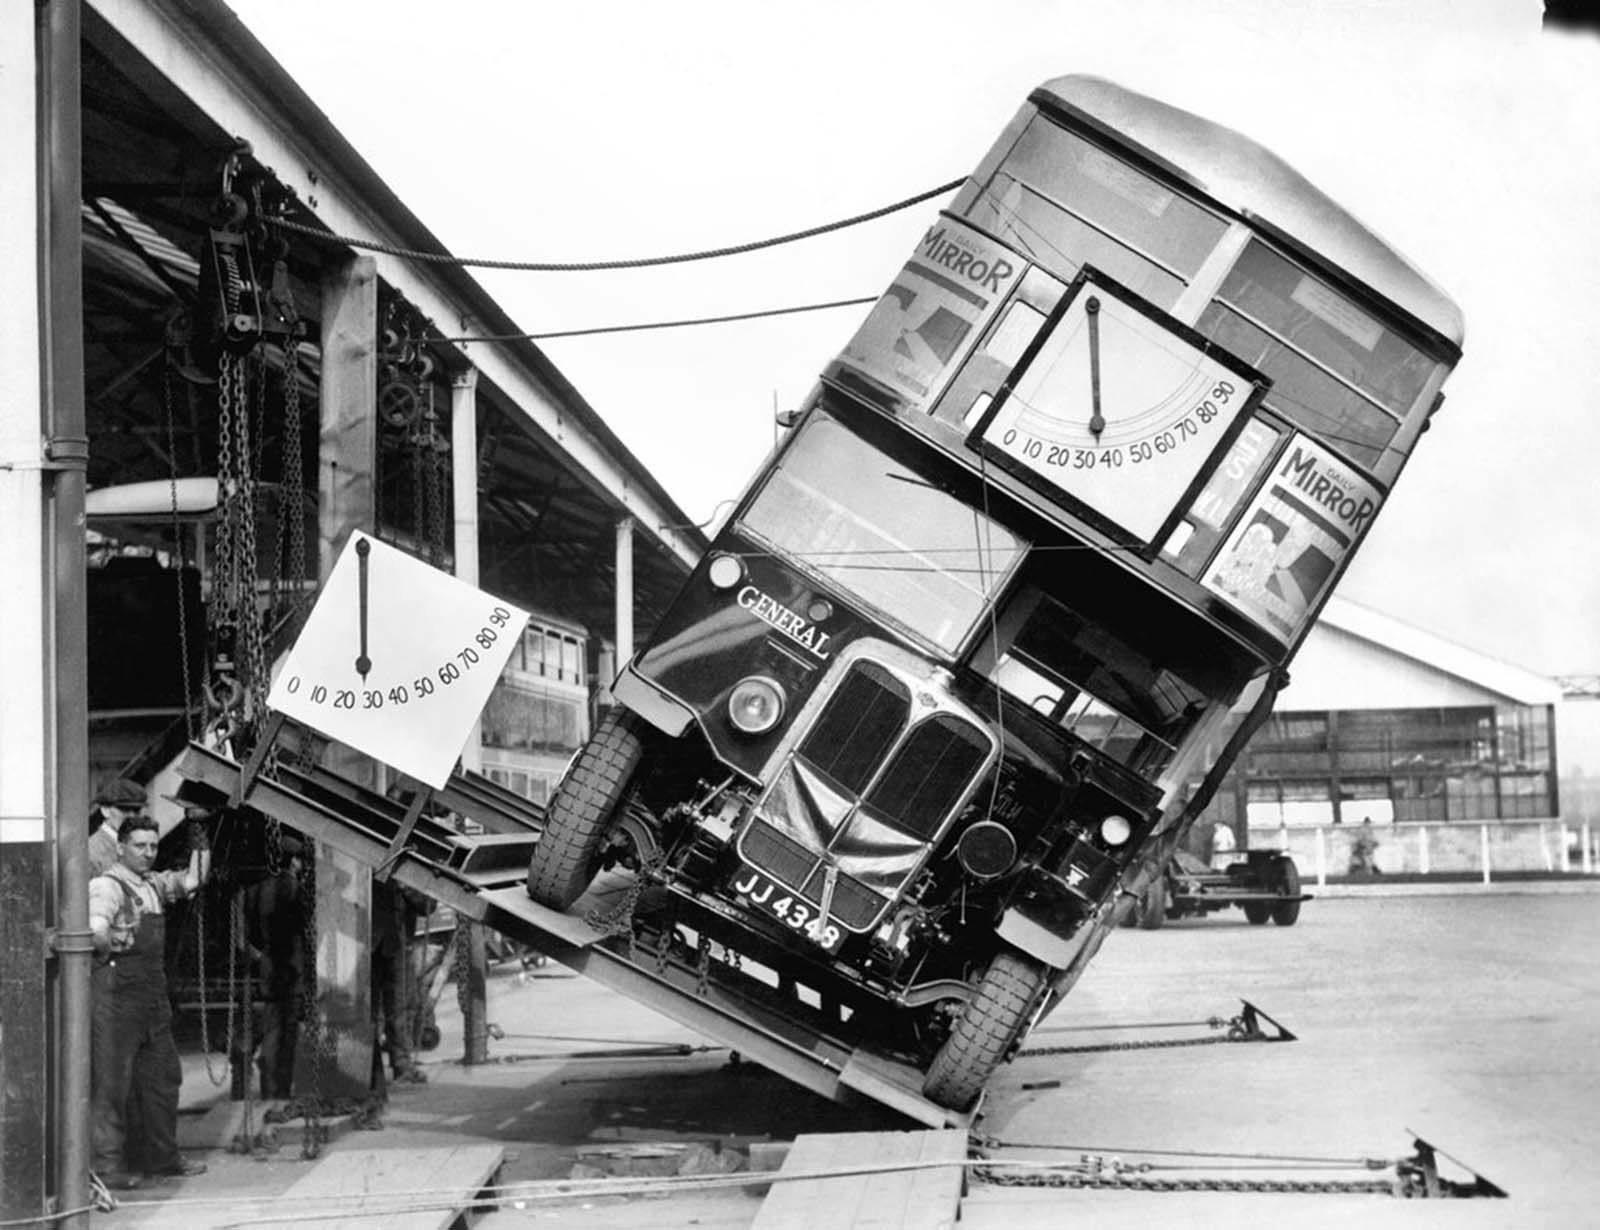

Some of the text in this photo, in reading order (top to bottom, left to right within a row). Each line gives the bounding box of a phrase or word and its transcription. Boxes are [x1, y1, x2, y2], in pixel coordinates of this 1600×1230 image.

[914, 226, 1014, 294] MIRROR
[1003, 381, 1236, 469] 0 10 20 30 40 50 60 70 80 90
[1280, 447, 1374, 533] MIRROR
[1327, 468, 1356, 492] DAILY
[287, 607, 511, 709] 0 10 20 30 40 50 60 70 80 90
[737, 586, 830, 660] GENERAL
[736, 874, 774, 903] JJ
